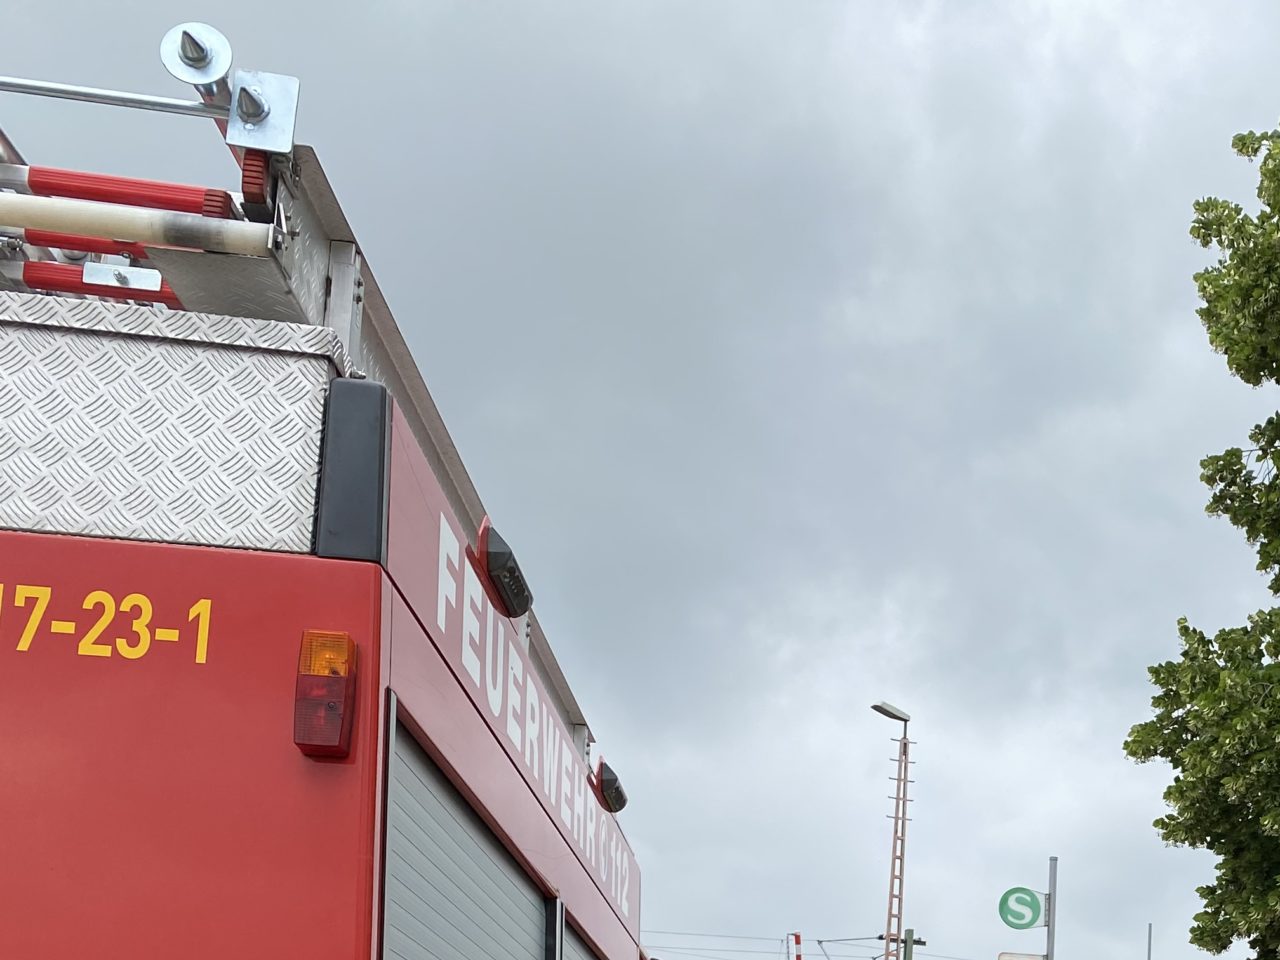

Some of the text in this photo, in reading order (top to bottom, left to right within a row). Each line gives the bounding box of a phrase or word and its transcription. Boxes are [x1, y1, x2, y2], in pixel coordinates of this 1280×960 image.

[0, 583, 212, 664] 7-23-1
[437, 511, 629, 917] FEUERWEHR 112
[1007, 893, 1033, 925] S
